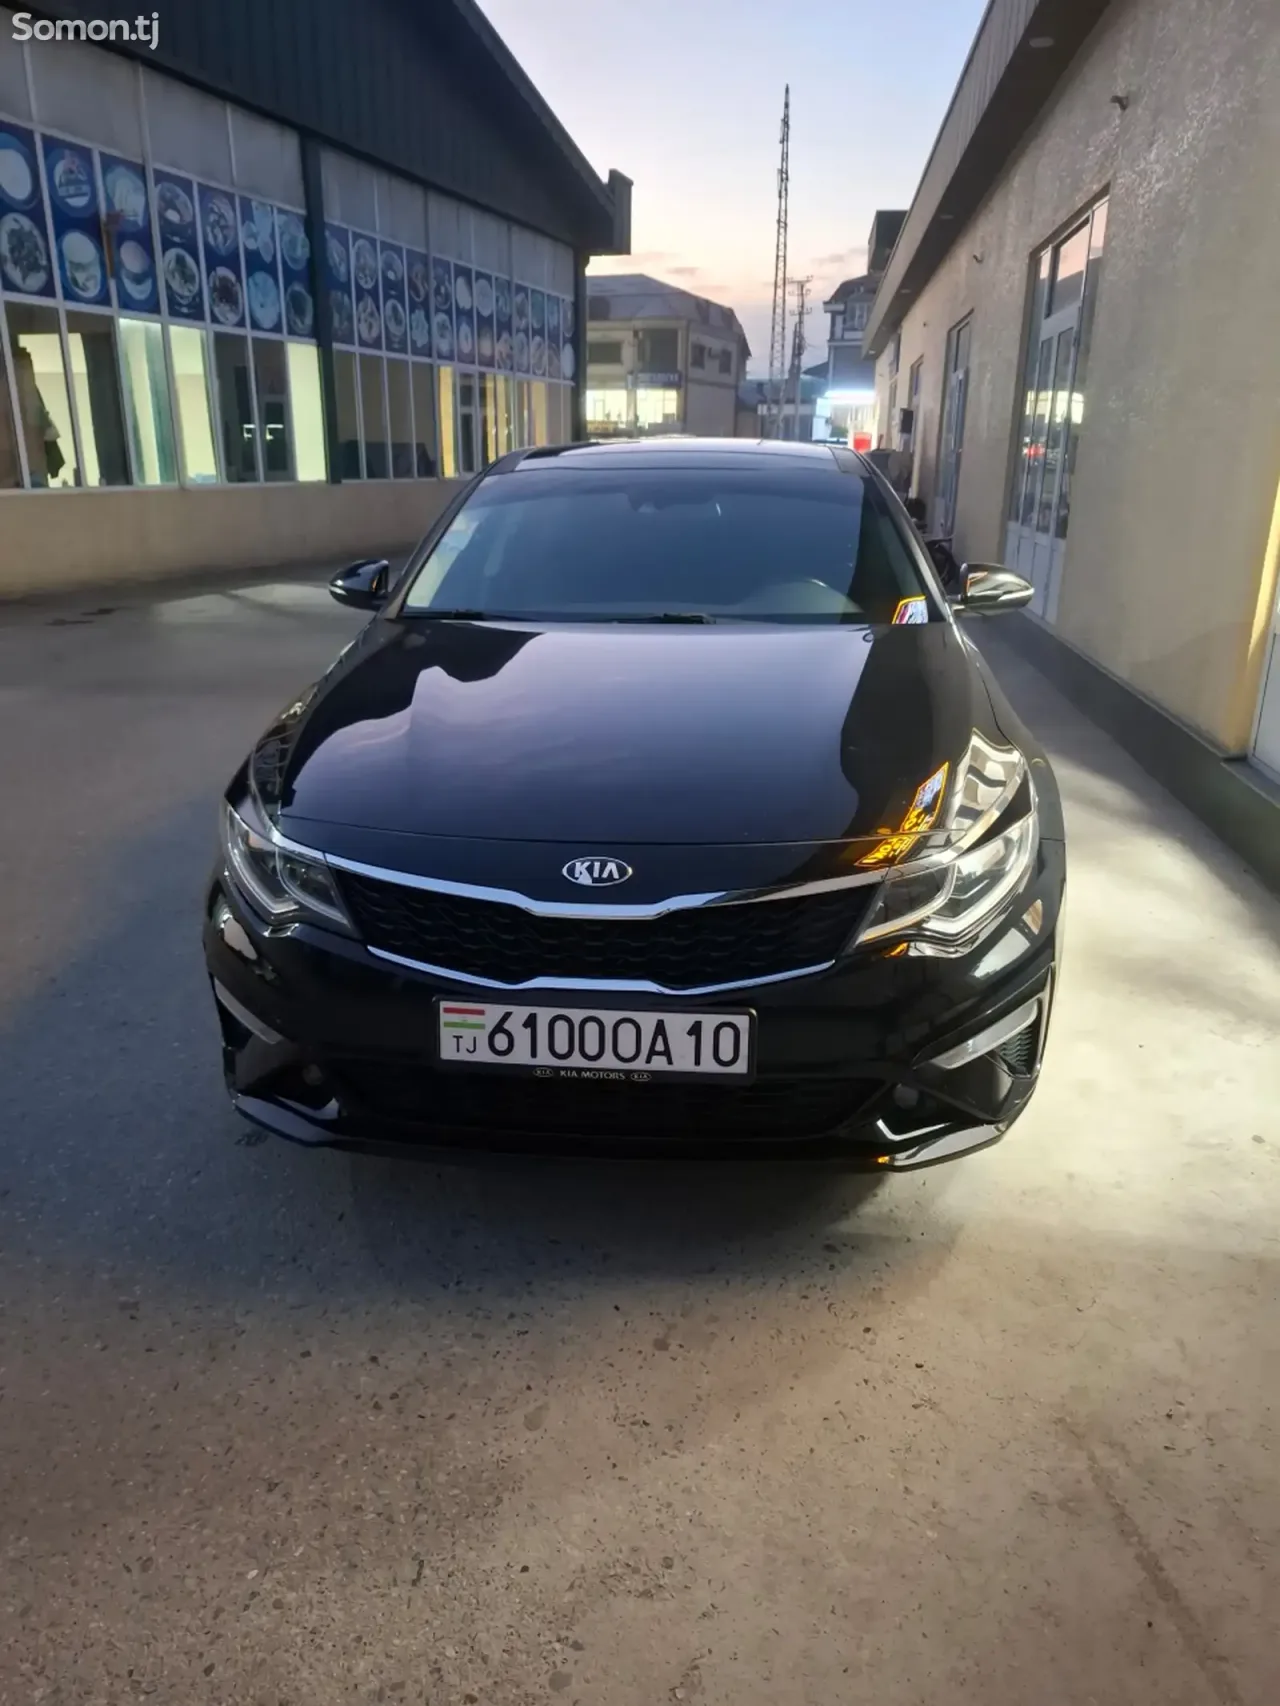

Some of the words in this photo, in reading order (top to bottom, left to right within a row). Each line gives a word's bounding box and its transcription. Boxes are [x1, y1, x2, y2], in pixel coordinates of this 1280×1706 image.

[573, 861, 620, 882] KIA
[452, 1035, 477, 1054] TJ
[581, 1071, 626, 1080] MOTORS
